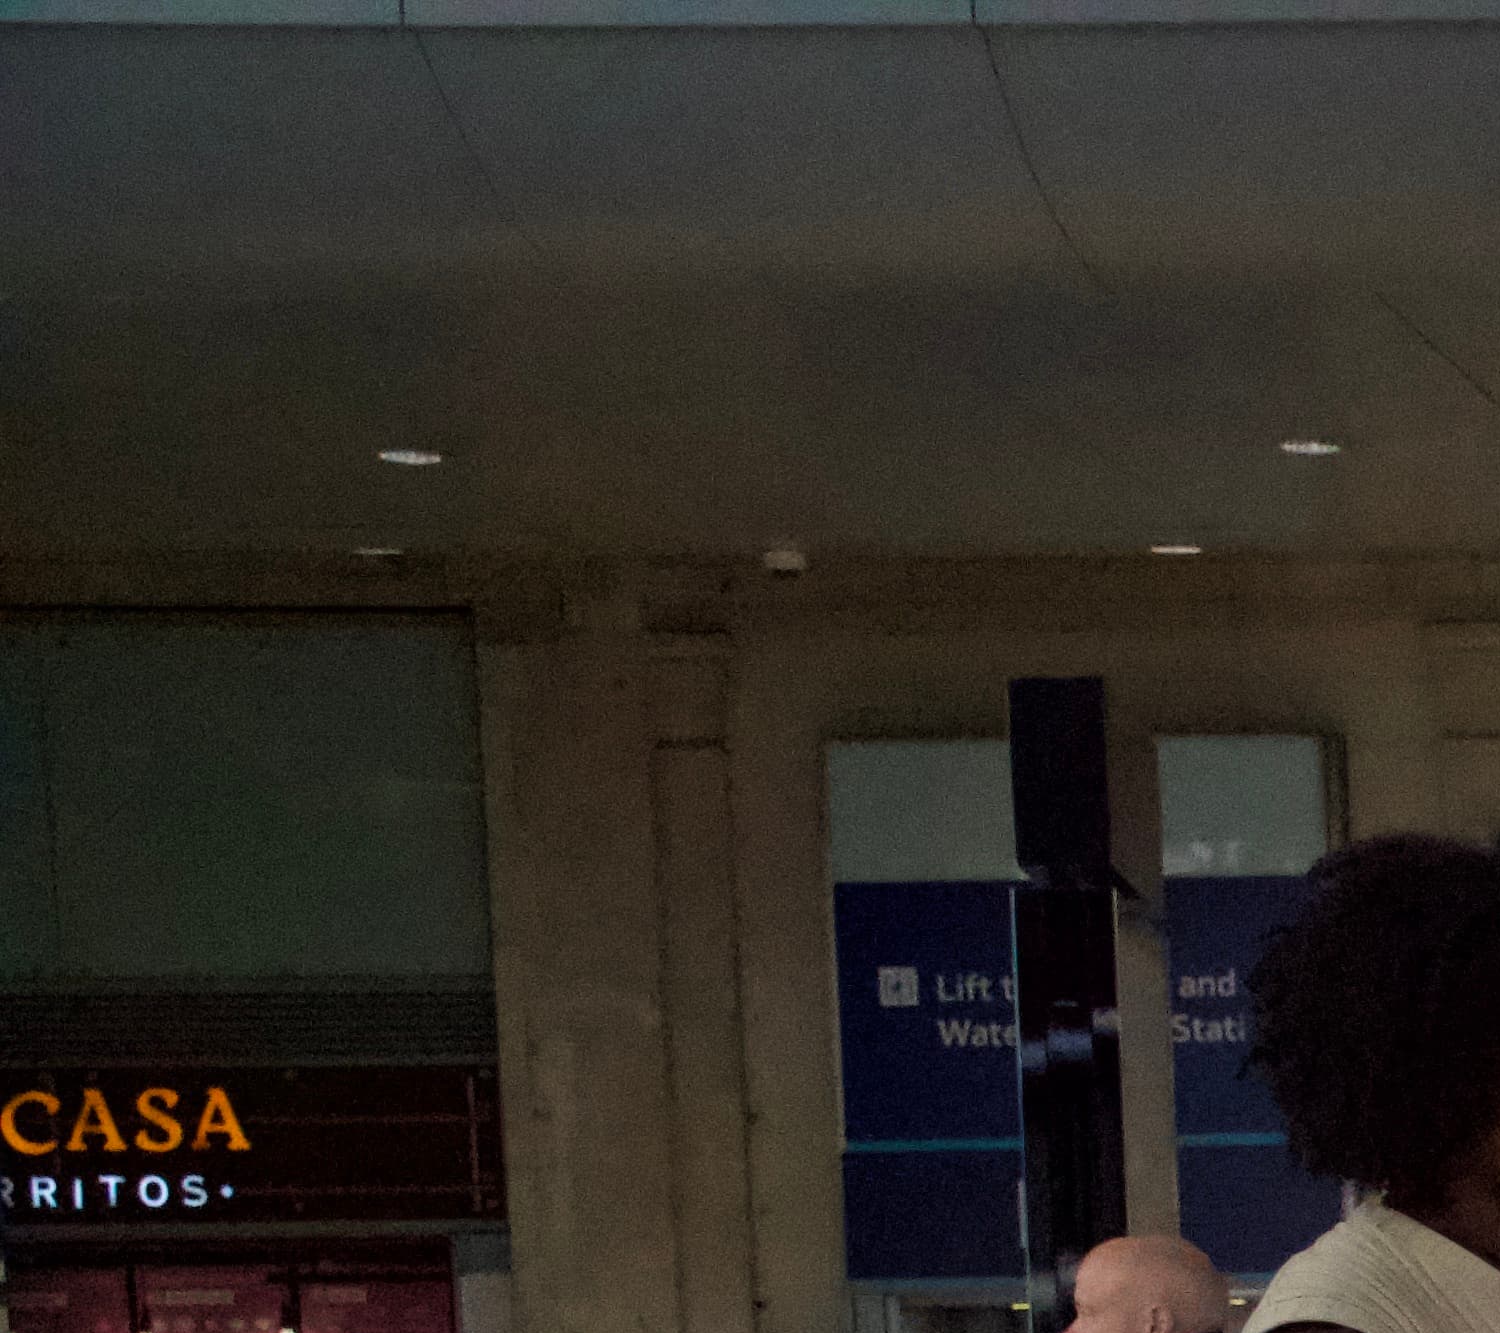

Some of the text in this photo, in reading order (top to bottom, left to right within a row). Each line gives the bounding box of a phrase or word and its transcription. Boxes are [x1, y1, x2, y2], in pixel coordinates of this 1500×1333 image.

[936, 971, 994, 1002] Lift
[1178, 967, 1237, 999] and
[0, 1086, 251, 1156] CASA
